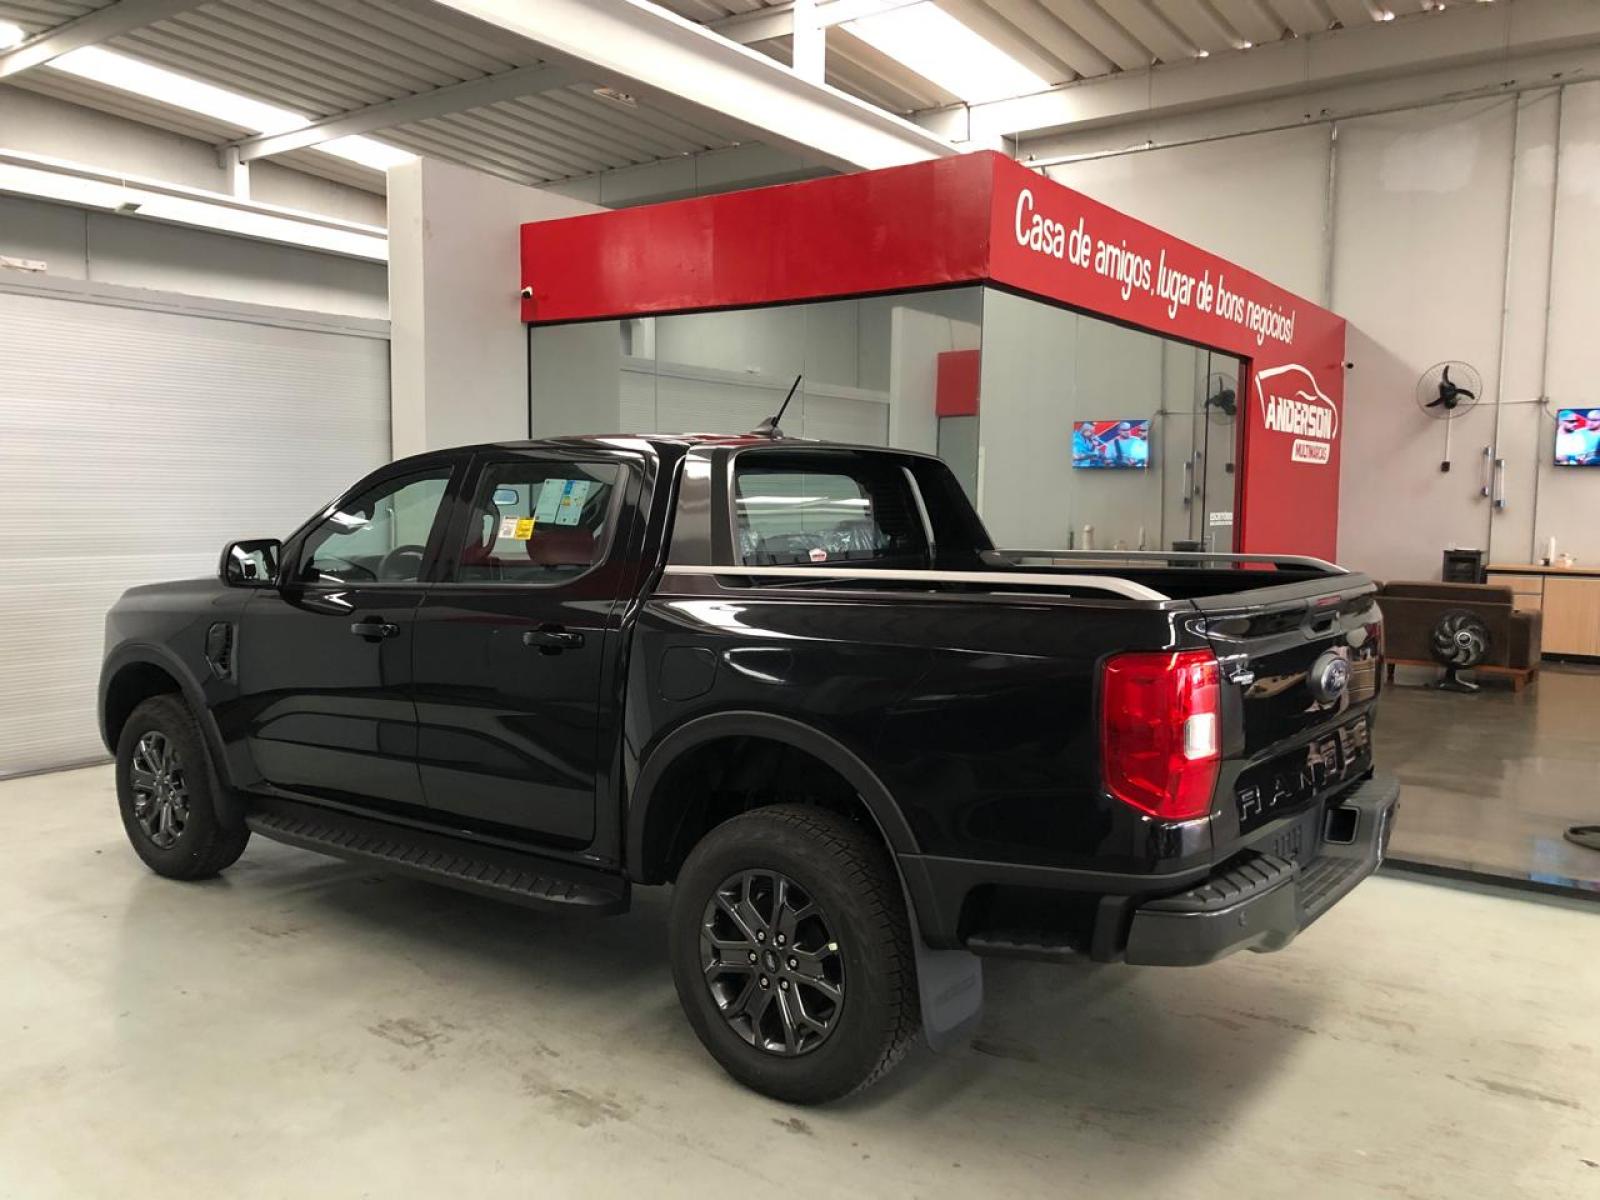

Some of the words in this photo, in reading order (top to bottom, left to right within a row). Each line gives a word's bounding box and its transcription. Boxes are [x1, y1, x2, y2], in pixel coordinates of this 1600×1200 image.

[1015, 188, 1066, 259] Casa
[1069, 216, 1092, 269] de
[1094, 240, 1155, 301] amigos,
[1156, 249, 1196, 320] lugar
[1196, 269, 1214, 314] de
[1215, 274, 1245, 325] bons
[1245, 303, 1296, 346] negócios!
[1264, 395, 1332, 440] ANDERSON
